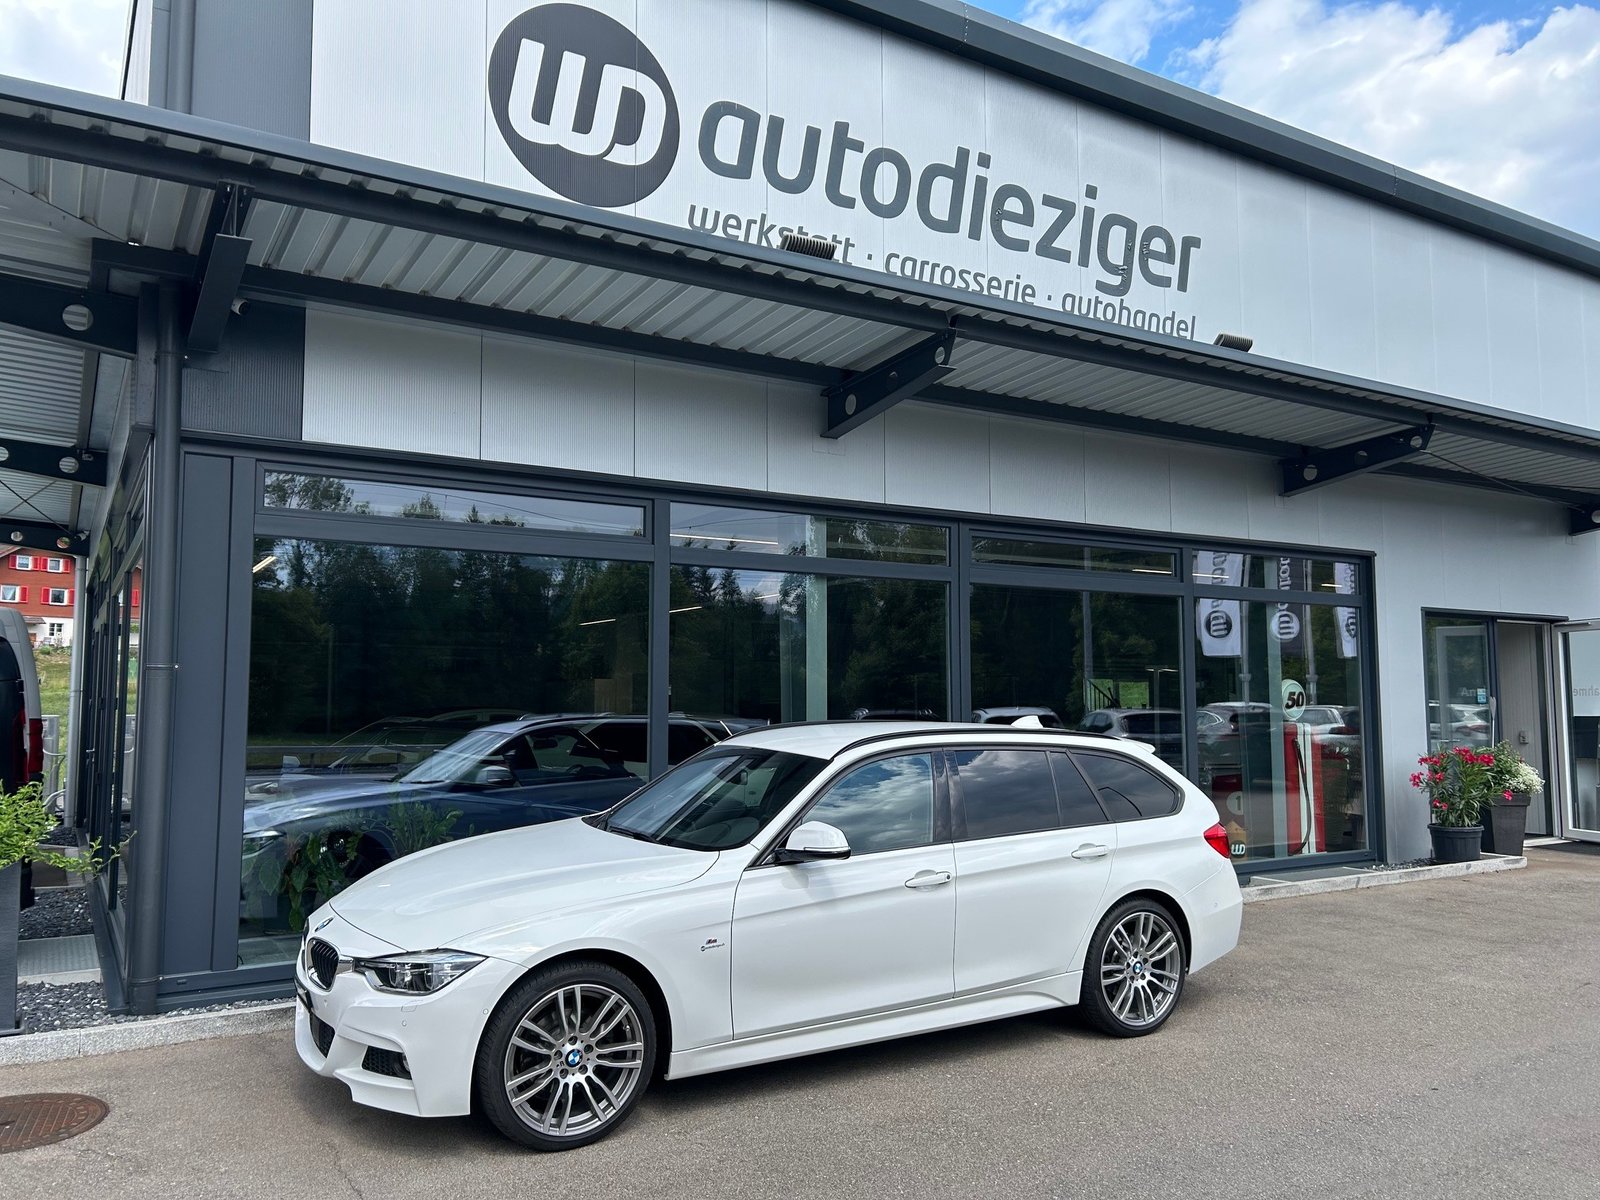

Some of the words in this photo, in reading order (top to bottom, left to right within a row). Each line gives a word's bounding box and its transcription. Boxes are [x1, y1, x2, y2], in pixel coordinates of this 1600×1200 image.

[698, 100, 1202, 297] autodieziger
[885, 252, 1037, 305] carrosserie
[1061, 292, 1196, 341] autohandel
[1285, 691, 1305, 709] 50
